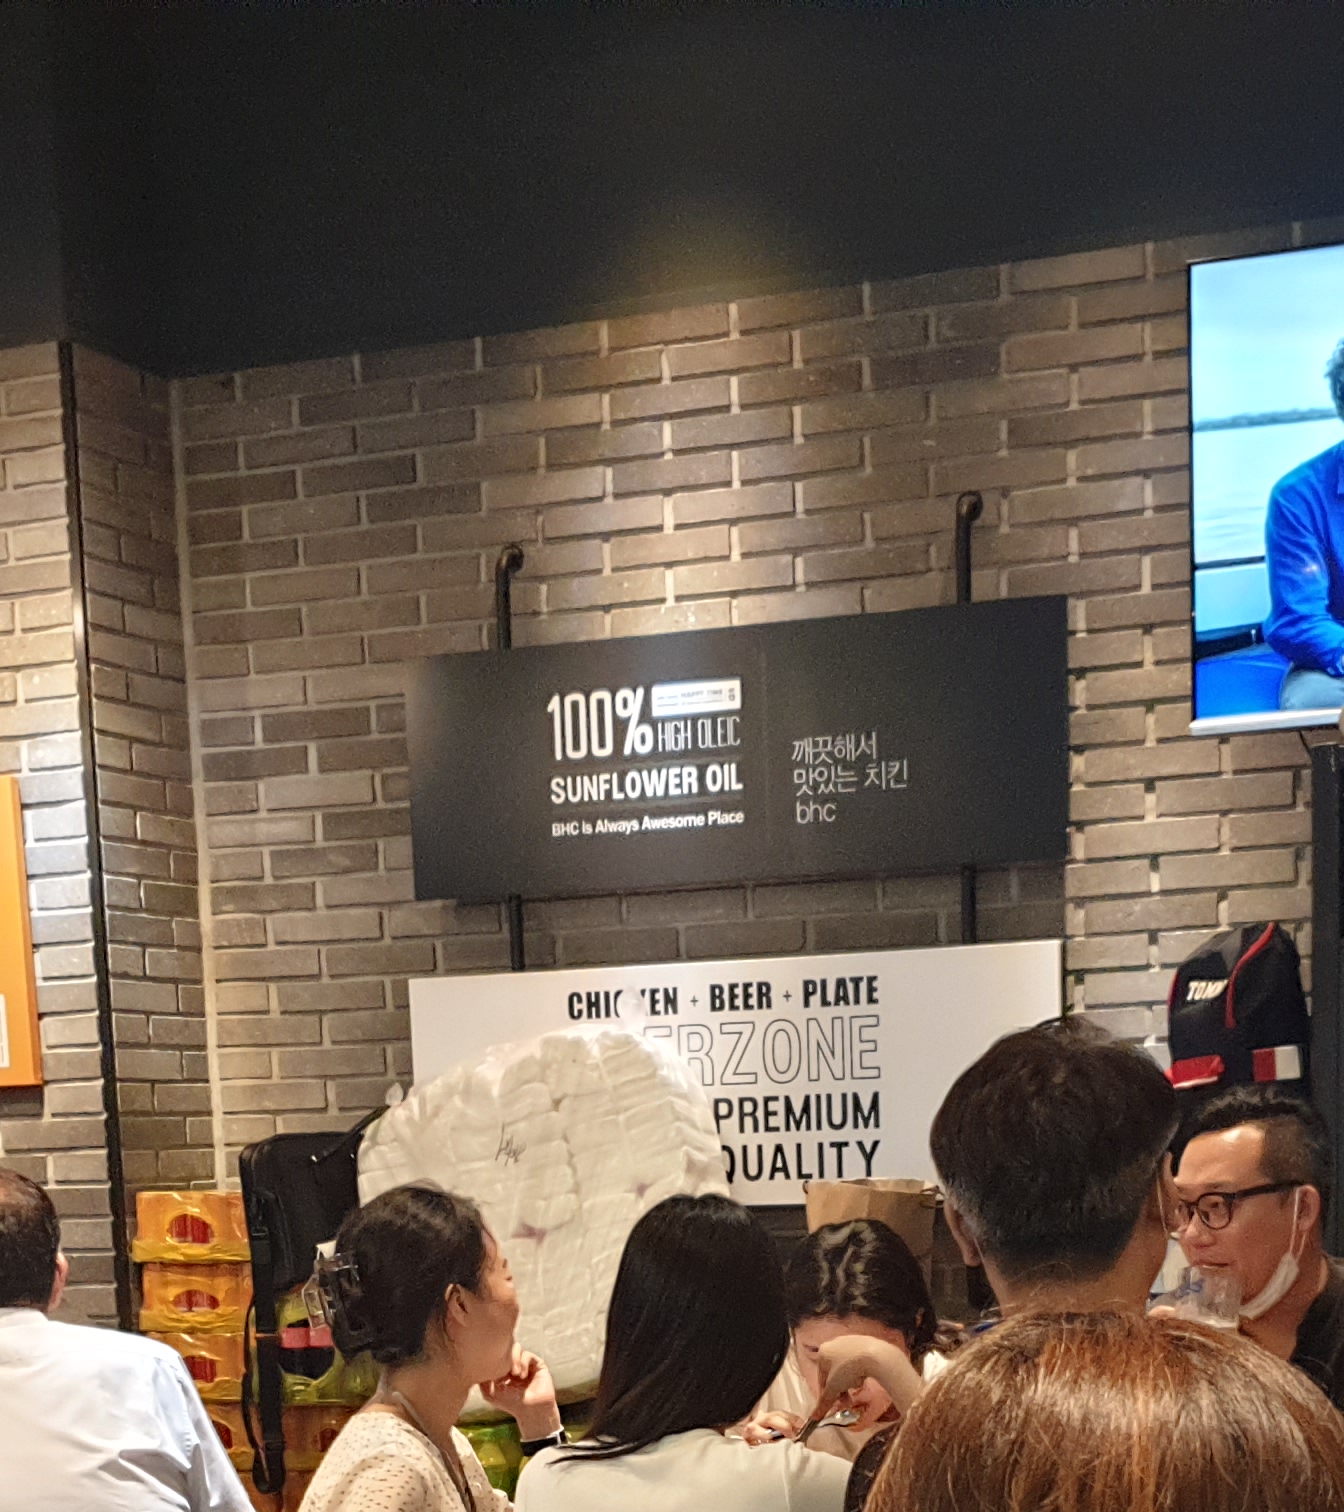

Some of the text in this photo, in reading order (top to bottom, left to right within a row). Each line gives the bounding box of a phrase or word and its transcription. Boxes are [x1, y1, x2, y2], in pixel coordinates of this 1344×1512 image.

[548, 686, 654, 761] 100%
[658, 716, 742, 752] HIGH OLEIC
[791, 732, 876, 765] 깨끗해서
[550, 762, 743, 804] SUNFLOWER OIL
[794, 759, 907, 796] 맛있는 치킨
[552, 821, 579, 837] BHC
[595, 819, 639, 835] Always
[642, 814, 705, 831] Awesome
[708, 810, 745, 826] Place
[796, 800, 837, 824] bhc
[709, 981, 772, 1012] BEER
[802, 975, 879, 1008] PLATE
[644, 1015, 881, 1086] RZONE
[714, 1091, 881, 1134] PREMIUM
